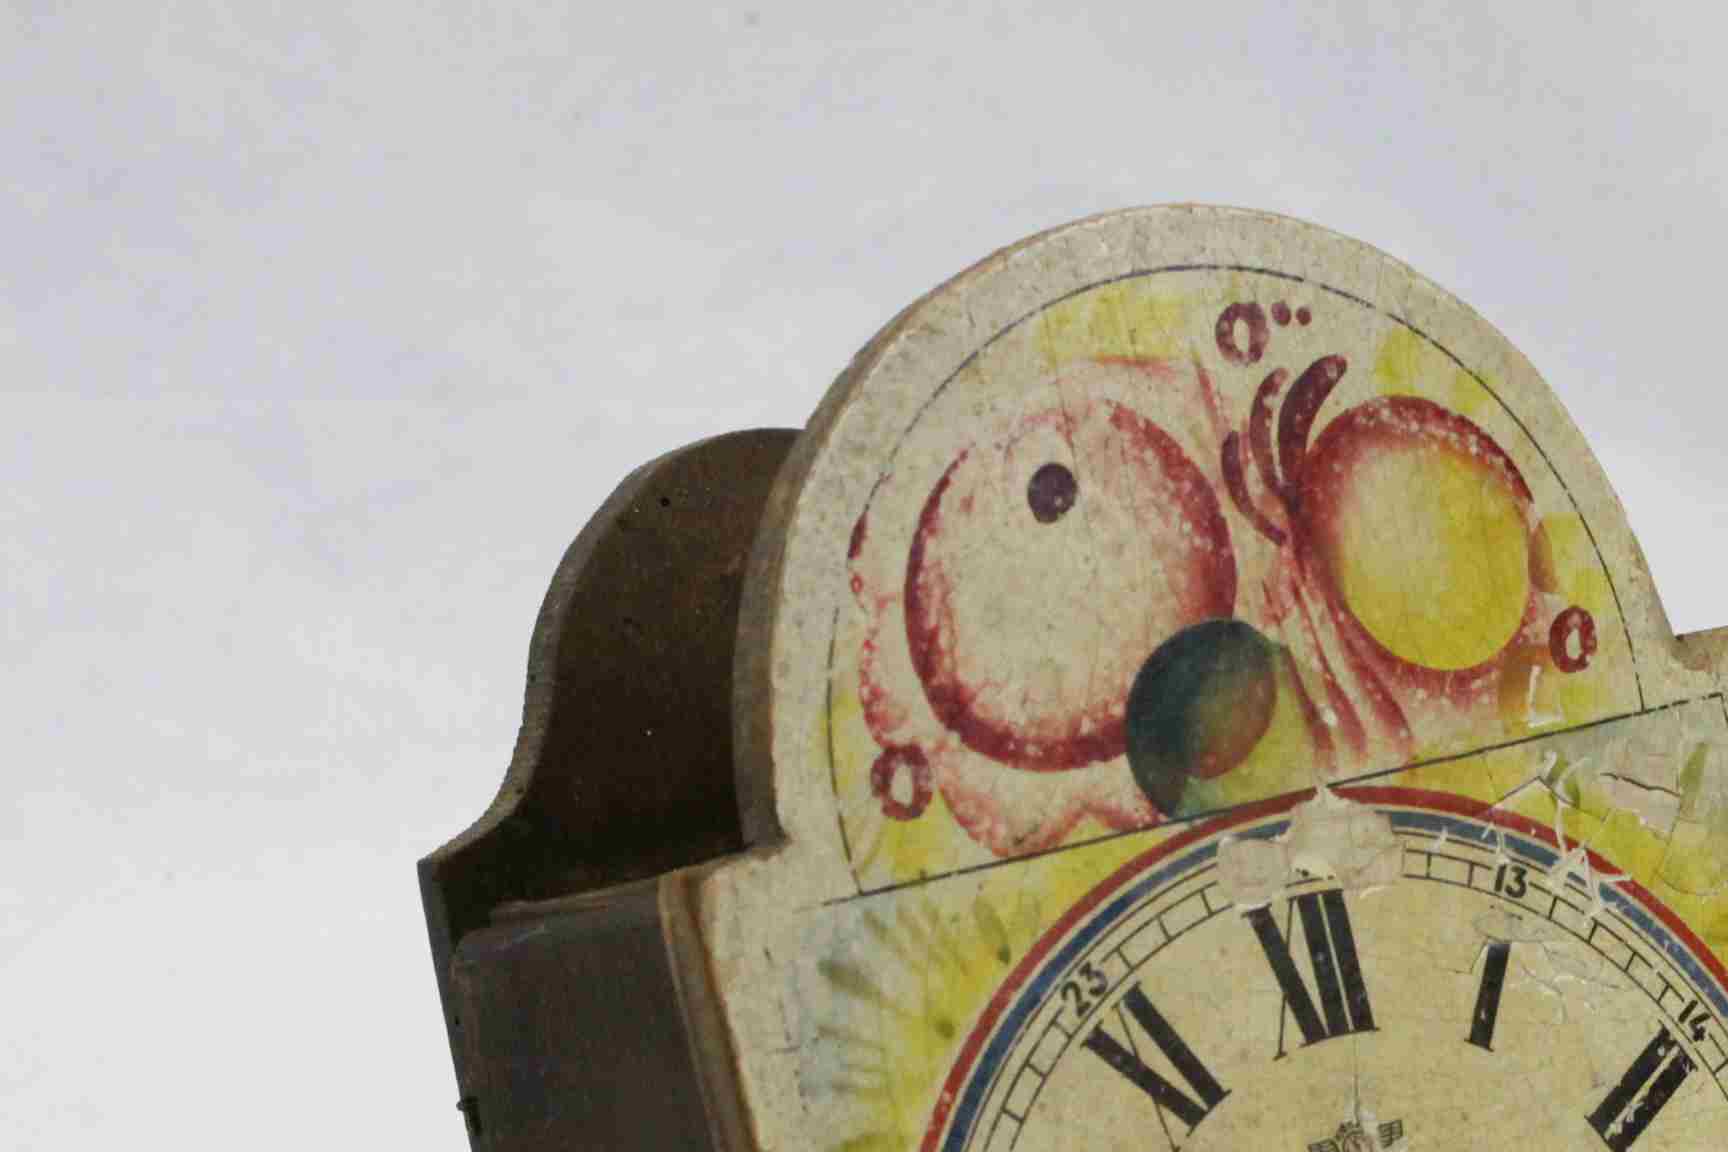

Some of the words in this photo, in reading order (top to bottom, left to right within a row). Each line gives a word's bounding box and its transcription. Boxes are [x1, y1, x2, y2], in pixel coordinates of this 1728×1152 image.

[1493, 862, 1529, 899] 13
[1059, 962, 1109, 1019] 23
[1239, 887, 1381, 1063] XII
[1675, 998, 1712, 1043] 14
